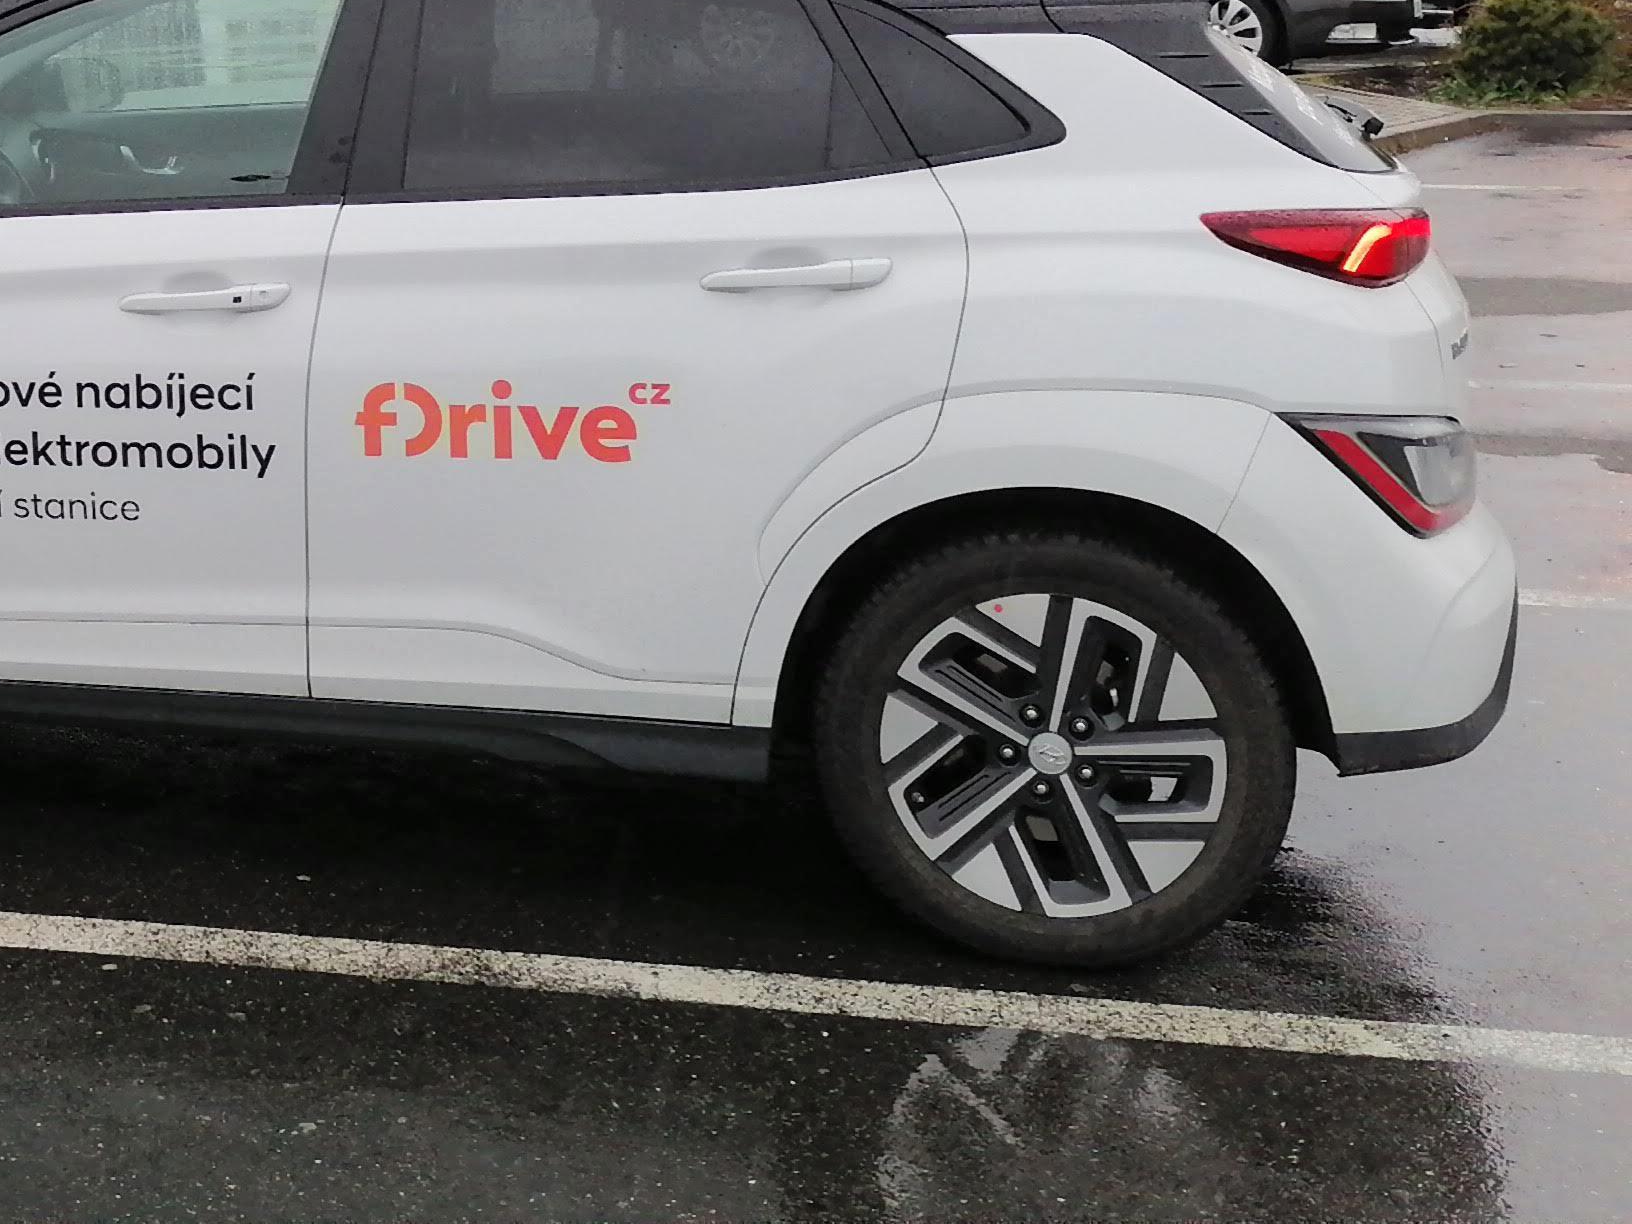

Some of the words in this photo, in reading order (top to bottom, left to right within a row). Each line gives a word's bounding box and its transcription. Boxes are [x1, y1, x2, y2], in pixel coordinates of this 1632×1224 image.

[75, 372, 256, 418] nabíjecí
[355, 379, 637, 463] fDrive
[13, 491, 141, 522] stanice
